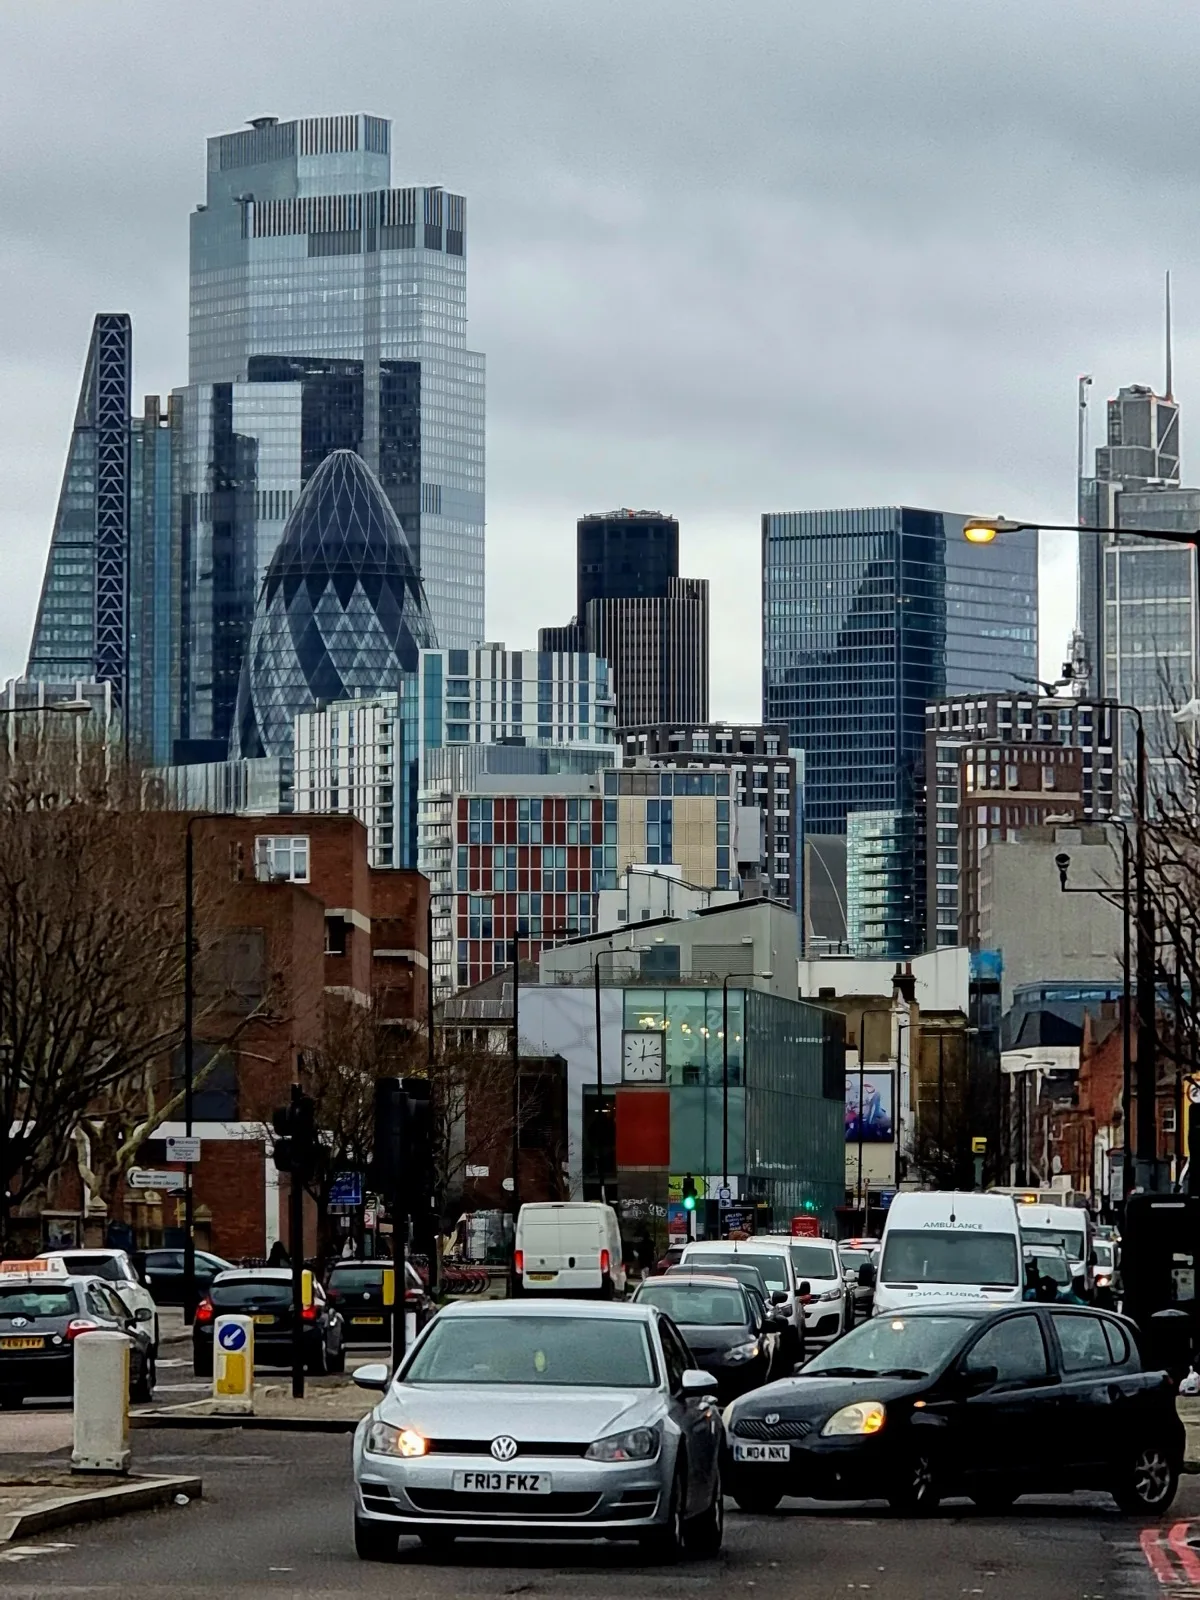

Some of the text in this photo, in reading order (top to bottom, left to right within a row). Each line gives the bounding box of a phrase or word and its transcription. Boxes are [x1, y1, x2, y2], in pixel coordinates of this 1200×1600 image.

[923, 1222, 984, 1230] AMBULANCE
[463, 1473, 540, 1491] FR13 FKZ
